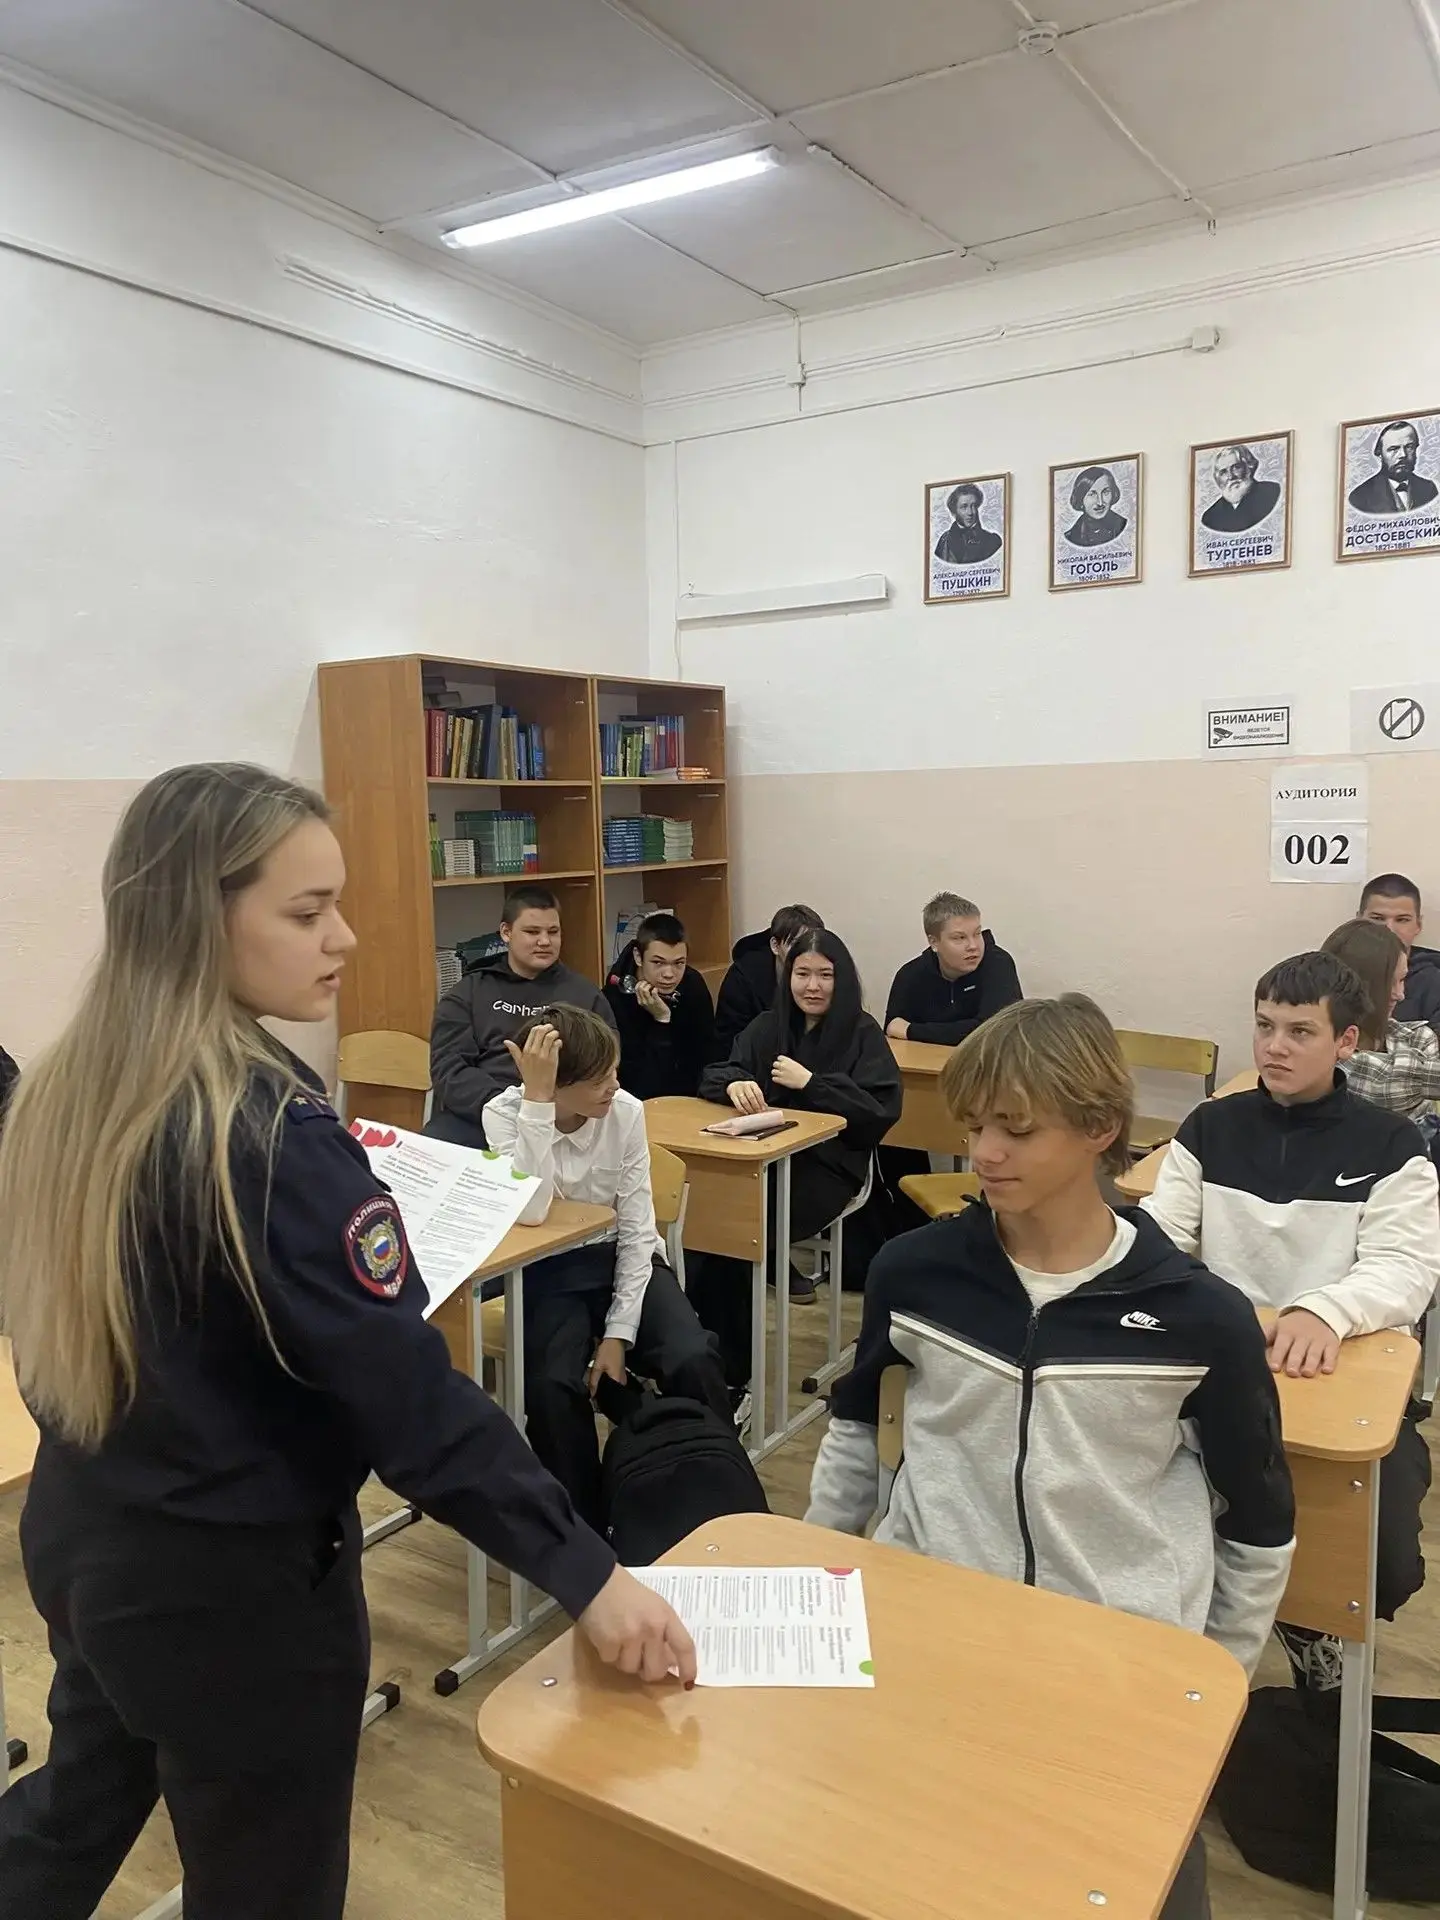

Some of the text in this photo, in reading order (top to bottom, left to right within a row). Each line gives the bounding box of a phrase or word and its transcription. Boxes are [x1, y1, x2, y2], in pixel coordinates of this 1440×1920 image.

[1206, 535, 1274, 550] ИВАН СЕРГЕЕВИЧ
[1345, 524, 1440, 548] ДОСТОЕВСКИЙ
[1089, 551, 1133, 561] ВАСИЛЬЕВИЧ
[1207, 544, 1273, 561] ТУРГЕНЕВ
[933, 567, 1001, 580] АЛЕКСАНДР СЕРГЕЕВИЧ
[1070, 560, 1119, 576] ГОГОЛЬ
[942, 575, 991, 591] ПУШКИН
[1213, 711, 1285, 725] ВНИМАНИЕ!
[1276, 787, 1357, 800] АУДИТОРИЯ
[1284, 834, 1350, 865] 002
[348, 1200, 394, 1239] ПОЛИЦИЯ
[1129, 1311, 1161, 1326] NIKE
